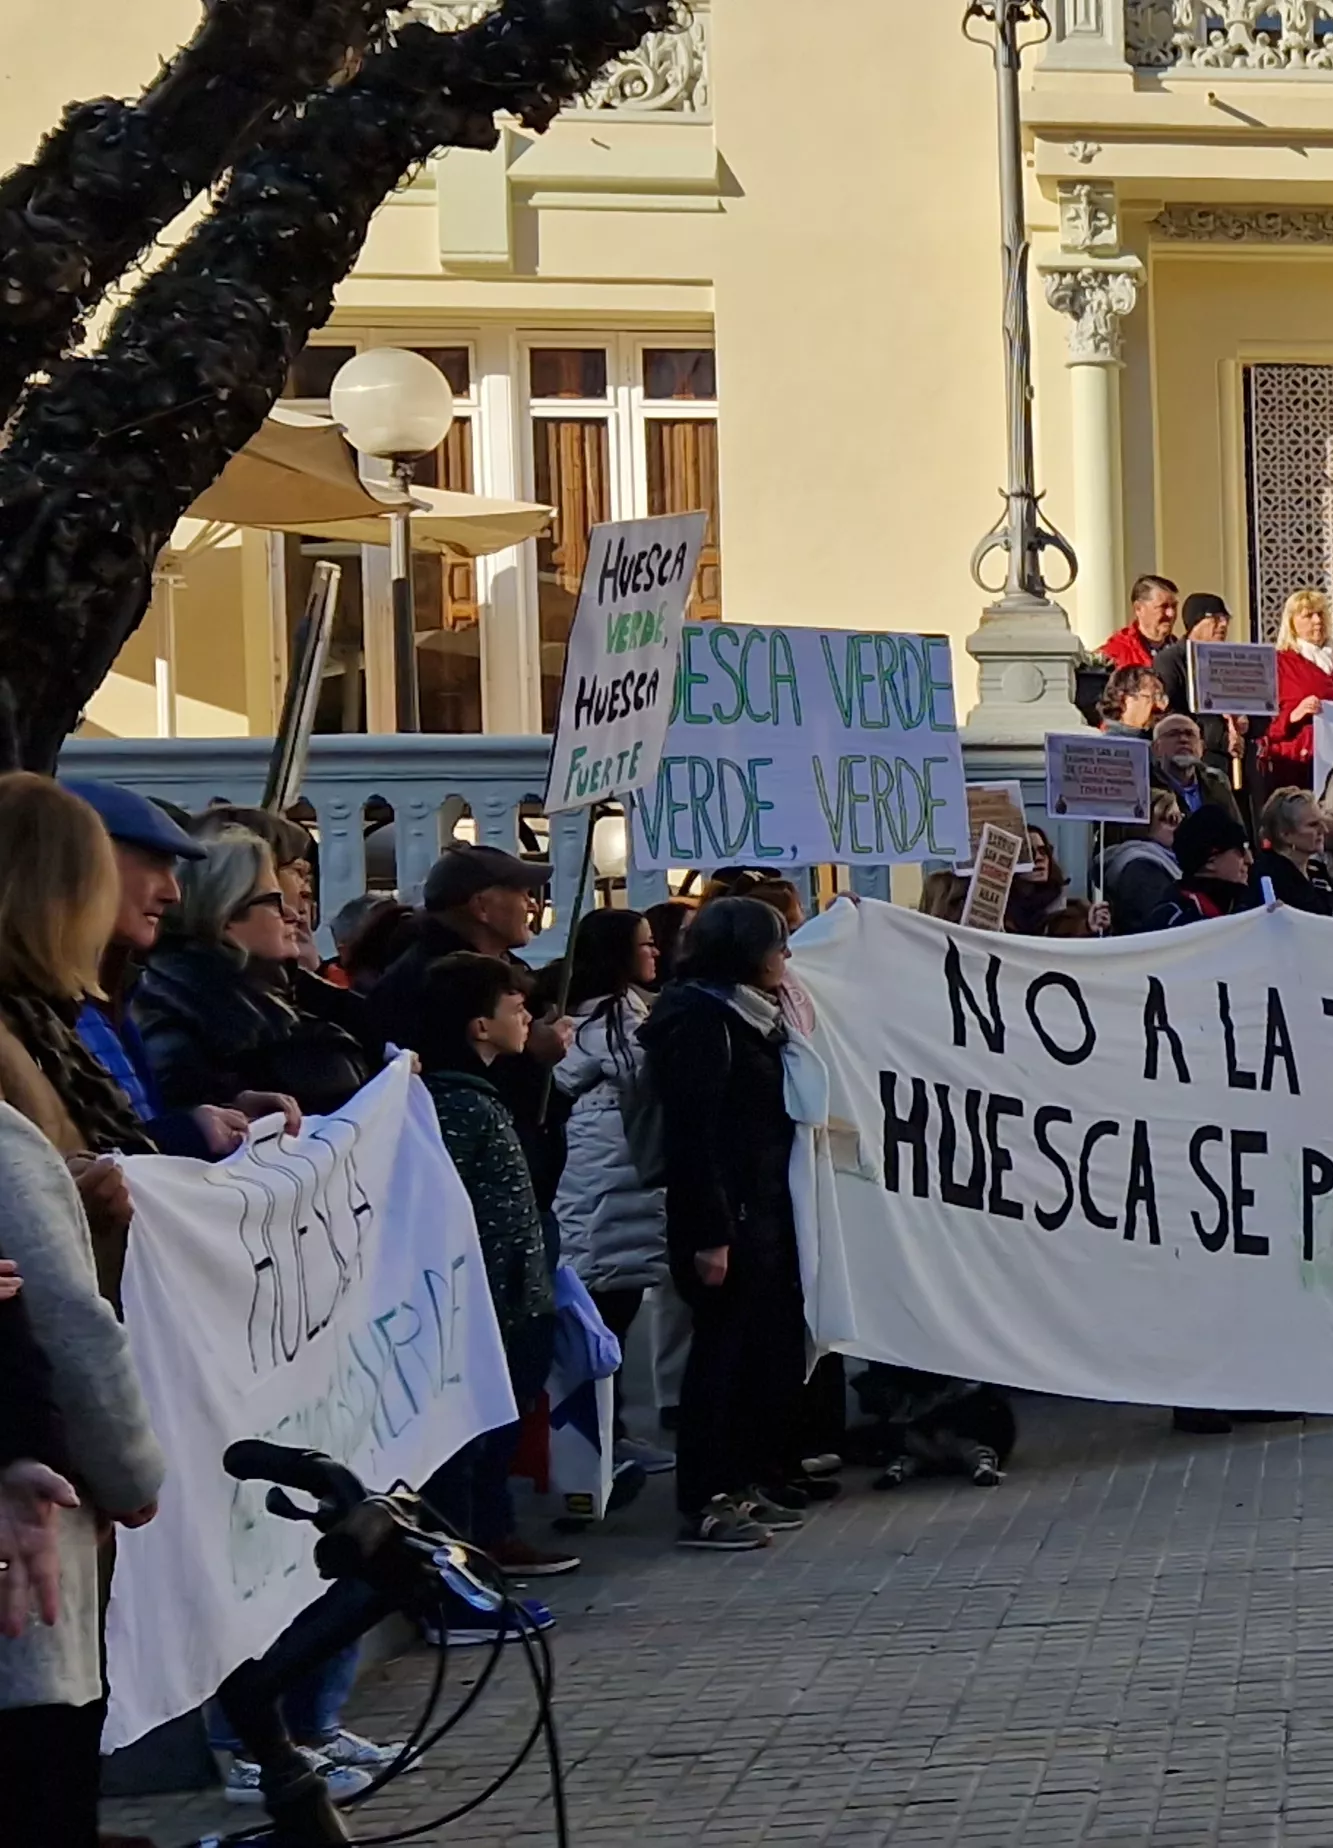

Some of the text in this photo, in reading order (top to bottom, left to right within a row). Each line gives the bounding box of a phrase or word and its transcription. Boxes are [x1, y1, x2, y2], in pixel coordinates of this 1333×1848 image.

[598, 537, 688, 606] HUESCA
[606, 601, 668, 655] VERDE,
[575, 667, 659, 731] HUESCA
[669, 626, 957, 733] ESCA VERDE
[812, 755, 957, 856] VERDE
[944, 936, 1097, 1066] NO
[1143, 975, 1191, 1085] A
[1217, 981, 1301, 1096] LA
[880, 1069, 1162, 1246] HUESCA
[1189, 1124, 1271, 1259] SE
